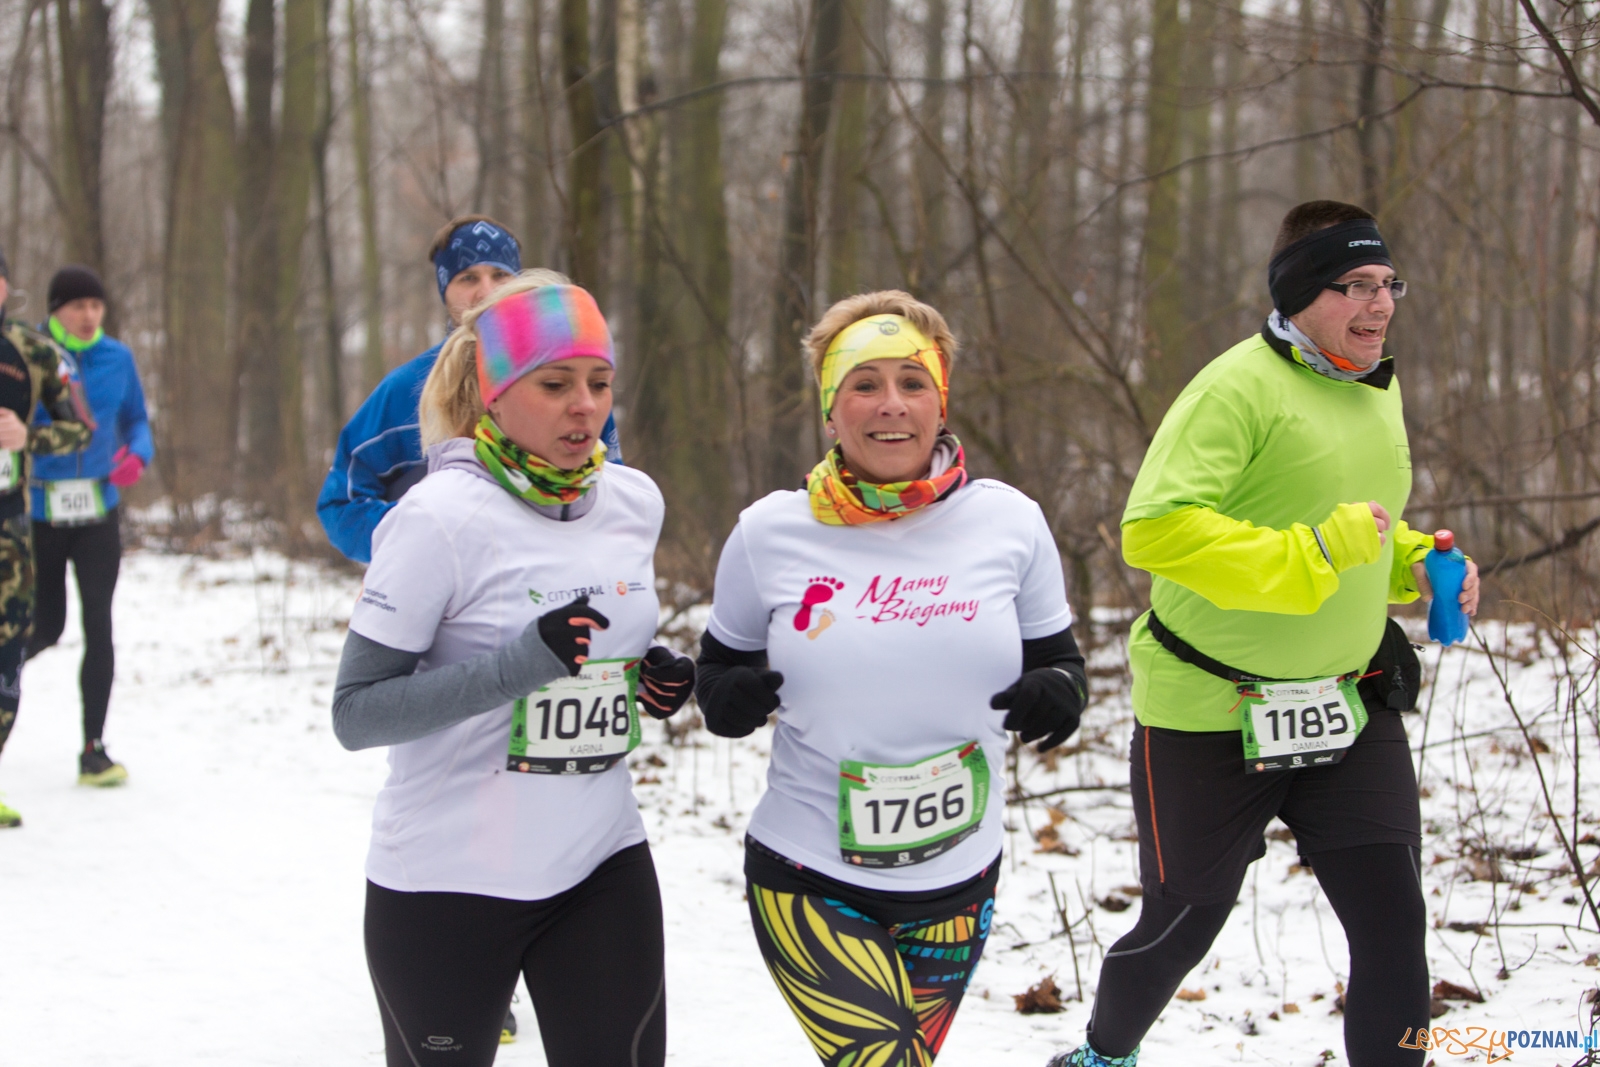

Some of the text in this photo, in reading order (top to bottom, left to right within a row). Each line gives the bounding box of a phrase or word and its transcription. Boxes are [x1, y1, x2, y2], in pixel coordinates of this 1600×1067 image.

[855, 574, 950, 609] Mamy
[535, 693, 630, 740] 1048
[1265, 701, 1349, 741] 1185
[569, 743, 604, 755] KARINA
[1292, 740, 1329, 752] DAMIAN
[864, 783, 965, 834] 1766
